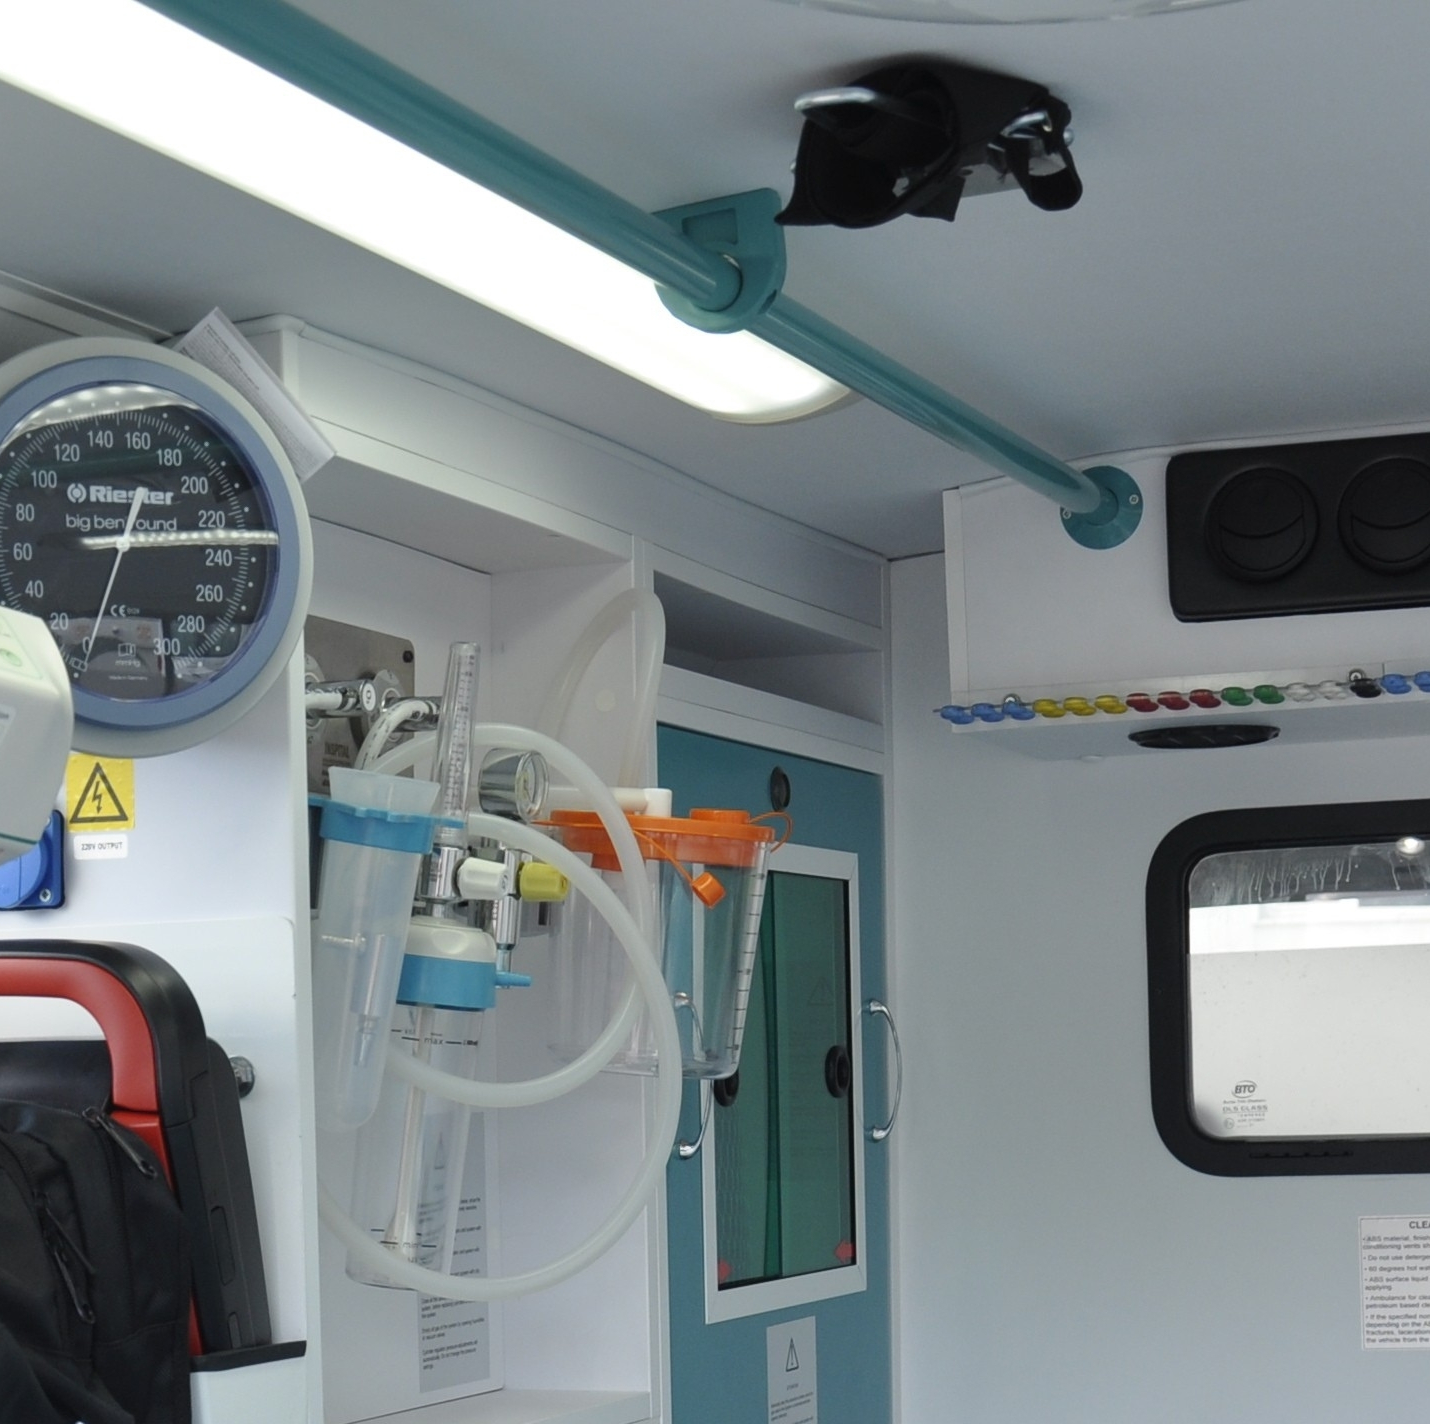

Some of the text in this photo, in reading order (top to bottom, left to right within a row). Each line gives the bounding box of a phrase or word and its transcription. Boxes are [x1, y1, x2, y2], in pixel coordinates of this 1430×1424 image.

[87, 430, 114, 449] 140
[124, 431, 151, 450] 160
[54, 443, 80, 462] 120
[156, 448, 183, 467] 180
[31, 469, 57, 489] 100
[180, 475, 209, 495] 200
[15, 503, 35, 522] 80
[197, 509, 226, 528] 220
[65, 513, 177, 532] big ben ound
[13, 542, 33, 561] 60
[204, 548, 233, 568] 240
[24, 580, 44, 598] 40
[196, 584, 223, 602] 260
[50, 612, 69, 630] 20
[177, 615, 205, 633] 280
[82, 636, 91, 654] 0
[153, 638, 181, 656] 300
[97, 842, 123, 850] OUTPUT
[424, 1037, 443, 1045] max
[1235, 1084, 1256, 1094] BTO
